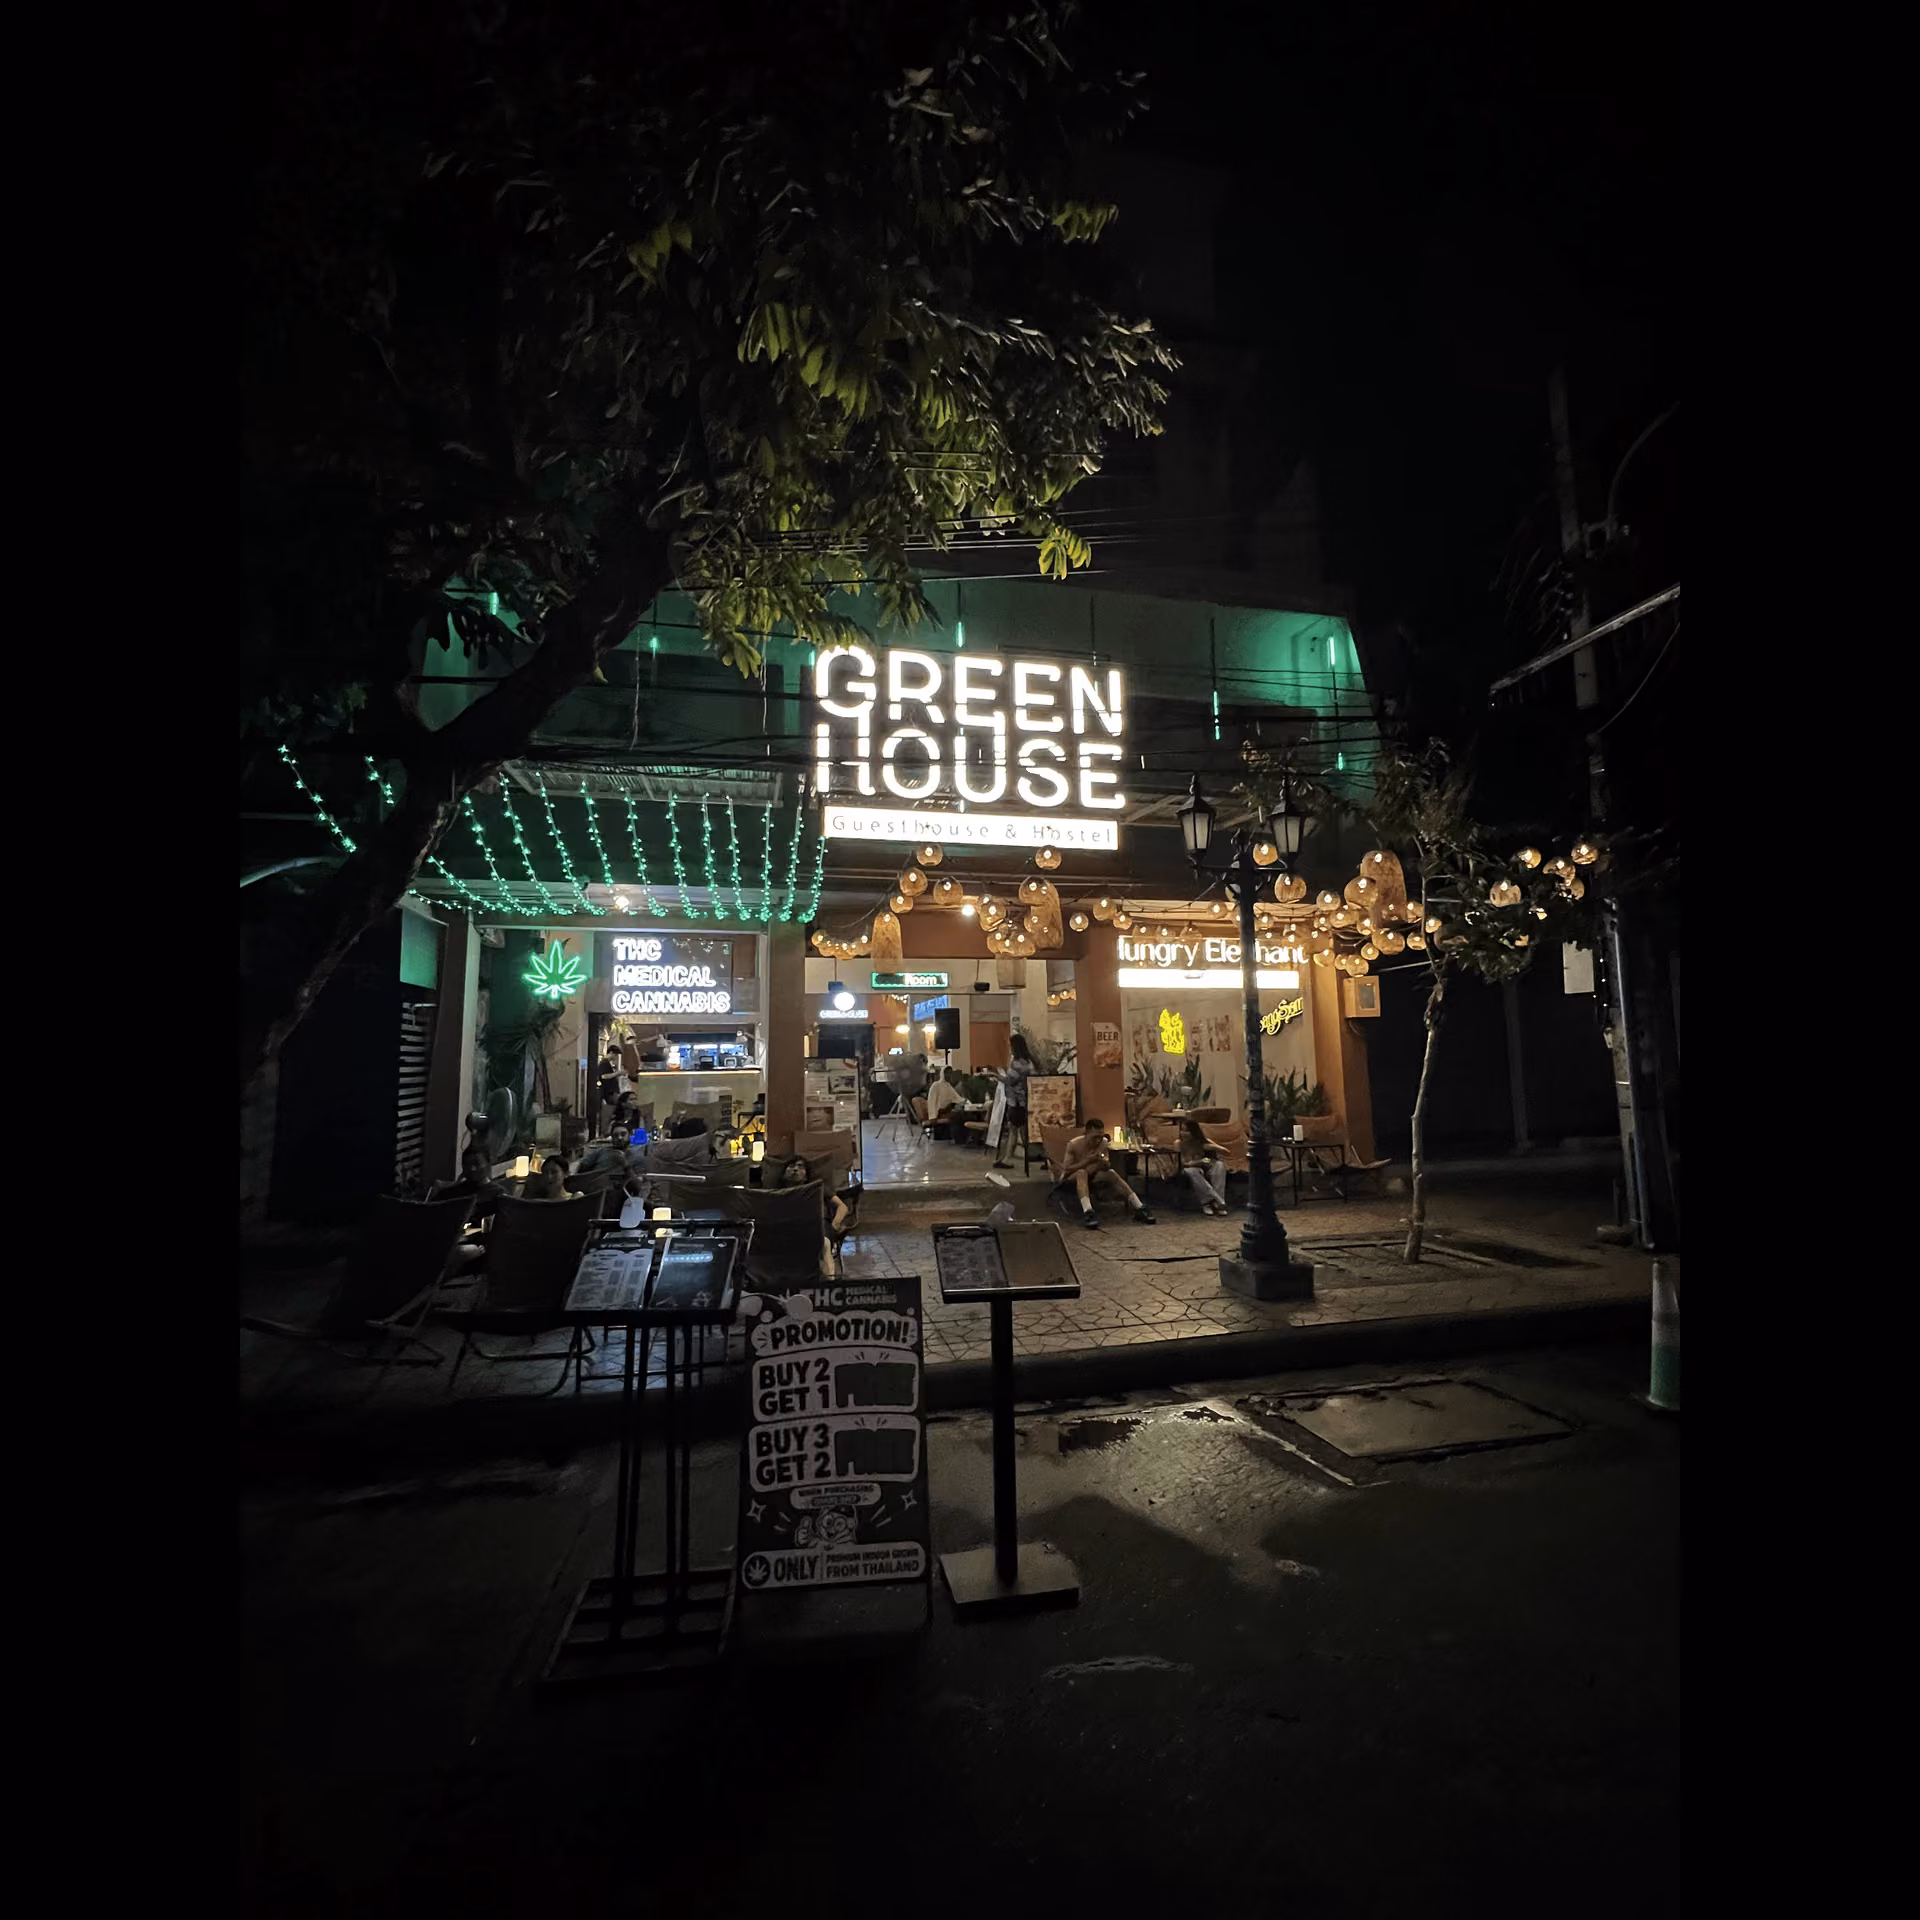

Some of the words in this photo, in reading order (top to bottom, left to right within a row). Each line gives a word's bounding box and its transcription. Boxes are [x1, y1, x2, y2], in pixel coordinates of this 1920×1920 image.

[815, 645, 1123, 736] GREEN
[815, 724, 1126, 809] HOUSE
[832, 815, 989, 838] Guesthouse
[1005, 823, 1017, 839] &
[1033, 824, 1110, 843] Hostel
[612, 937, 661, 961] THC
[1205, 939, 1309, 963] Elehant
[613, 964, 716, 987] MEDICAL
[611, 990, 731, 1013] CANNABIS
[1097, 1031, 1119, 1041] BEER
[770, 1318, 909, 1349] PROMOTION!
[759, 1361, 810, 1389] BUY
[814, 1358, 831, 1382] 2
[759, 1387, 810, 1416] GET
[818, 1384, 830, 1408] 1
[756, 1427, 808, 1457] BUY
[813, 1423, 829, 1449] 3
[756, 1454, 808, 1486] GET
[814, 1453, 831, 1478] 2
[774, 1555, 818, 1581] ONLY
[826, 1563, 860, 1578] FROM
[862, 1560, 920, 1576] THAILAND
